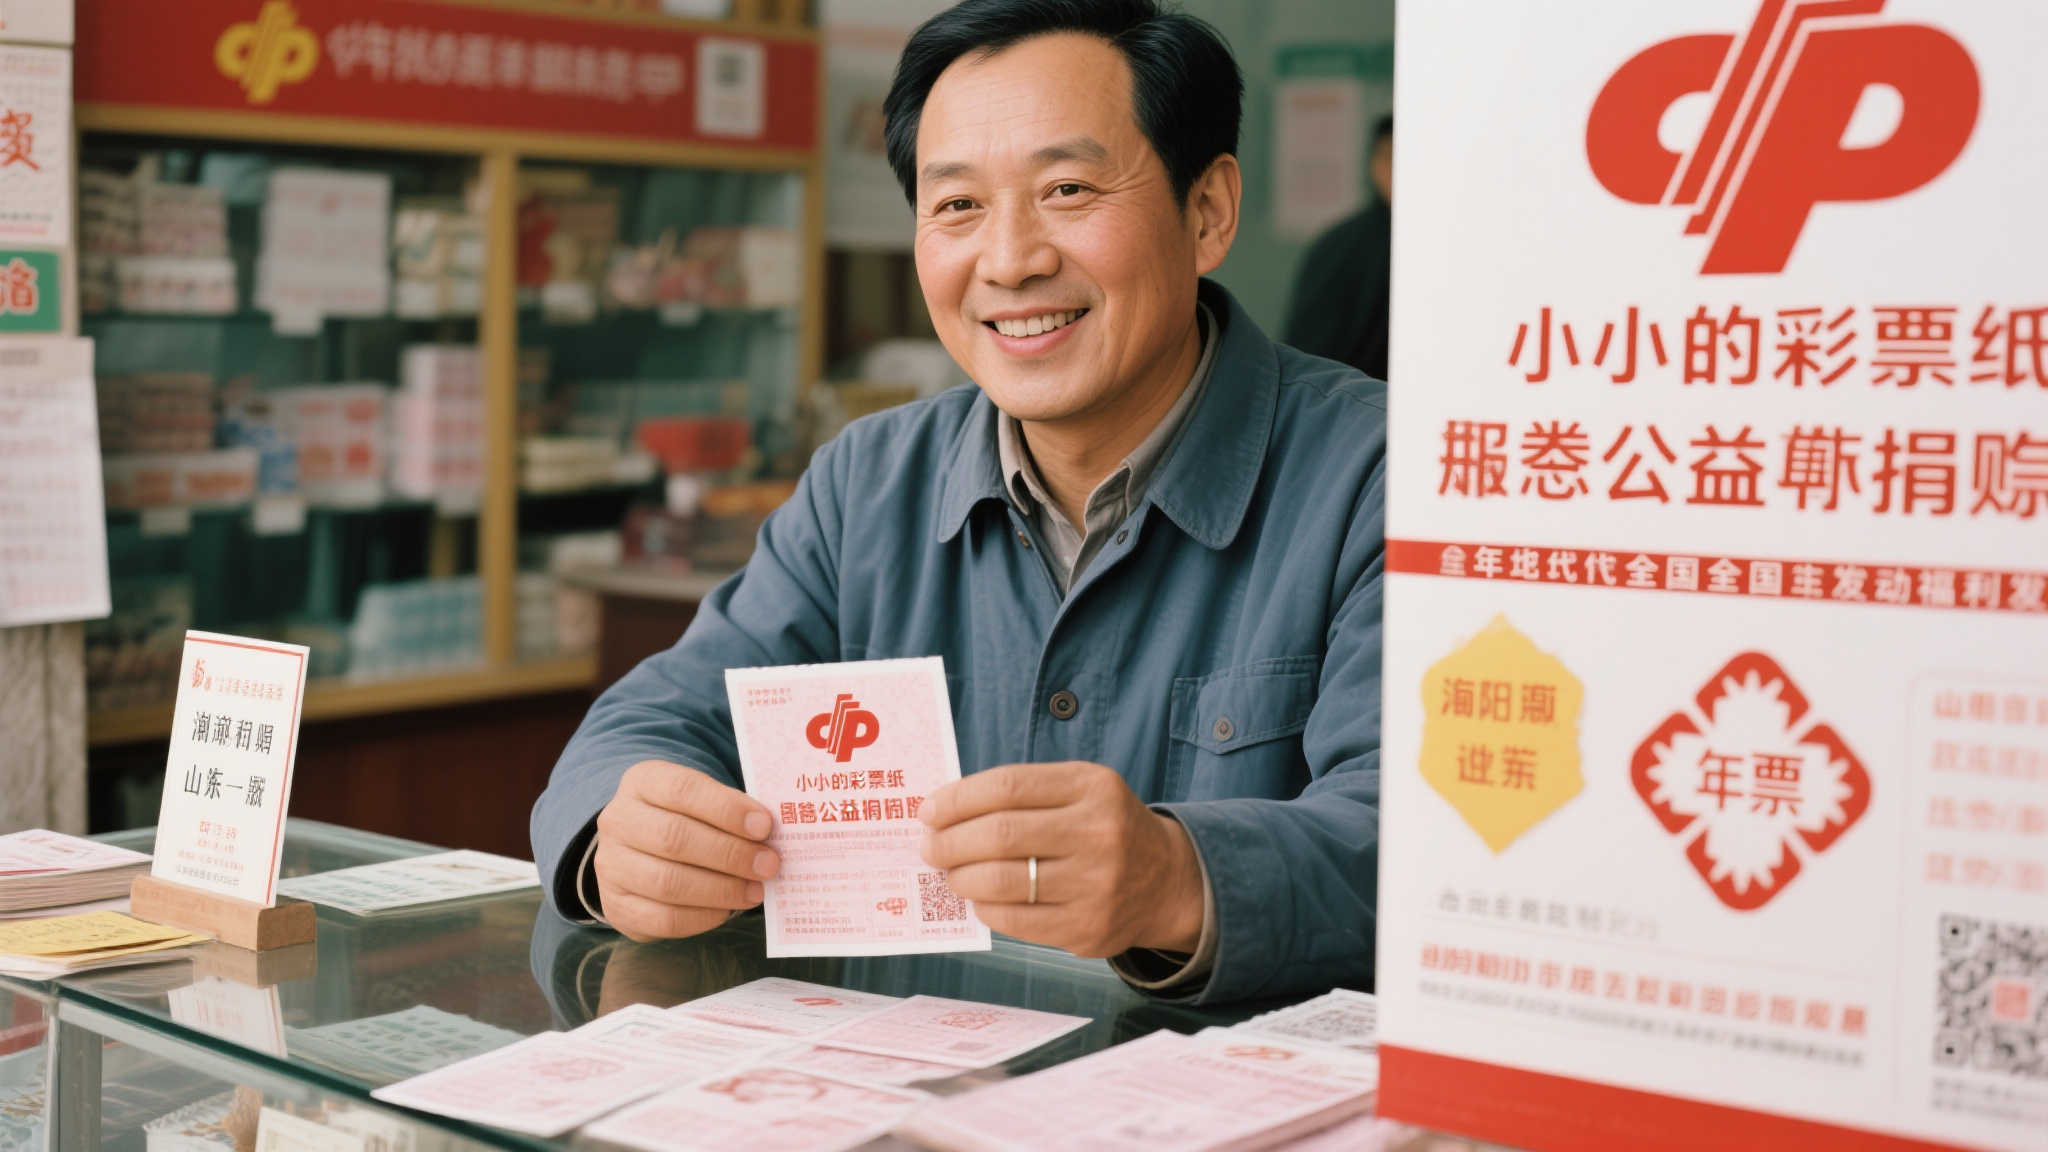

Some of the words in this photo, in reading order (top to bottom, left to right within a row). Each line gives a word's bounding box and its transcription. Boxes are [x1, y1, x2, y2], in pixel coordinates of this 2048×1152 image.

[1508, 305, 2048, 390] 小小的彩票纸
[797, 769, 905, 793] 小小的彩票纸
[1697, 749, 1804, 818] 年票
